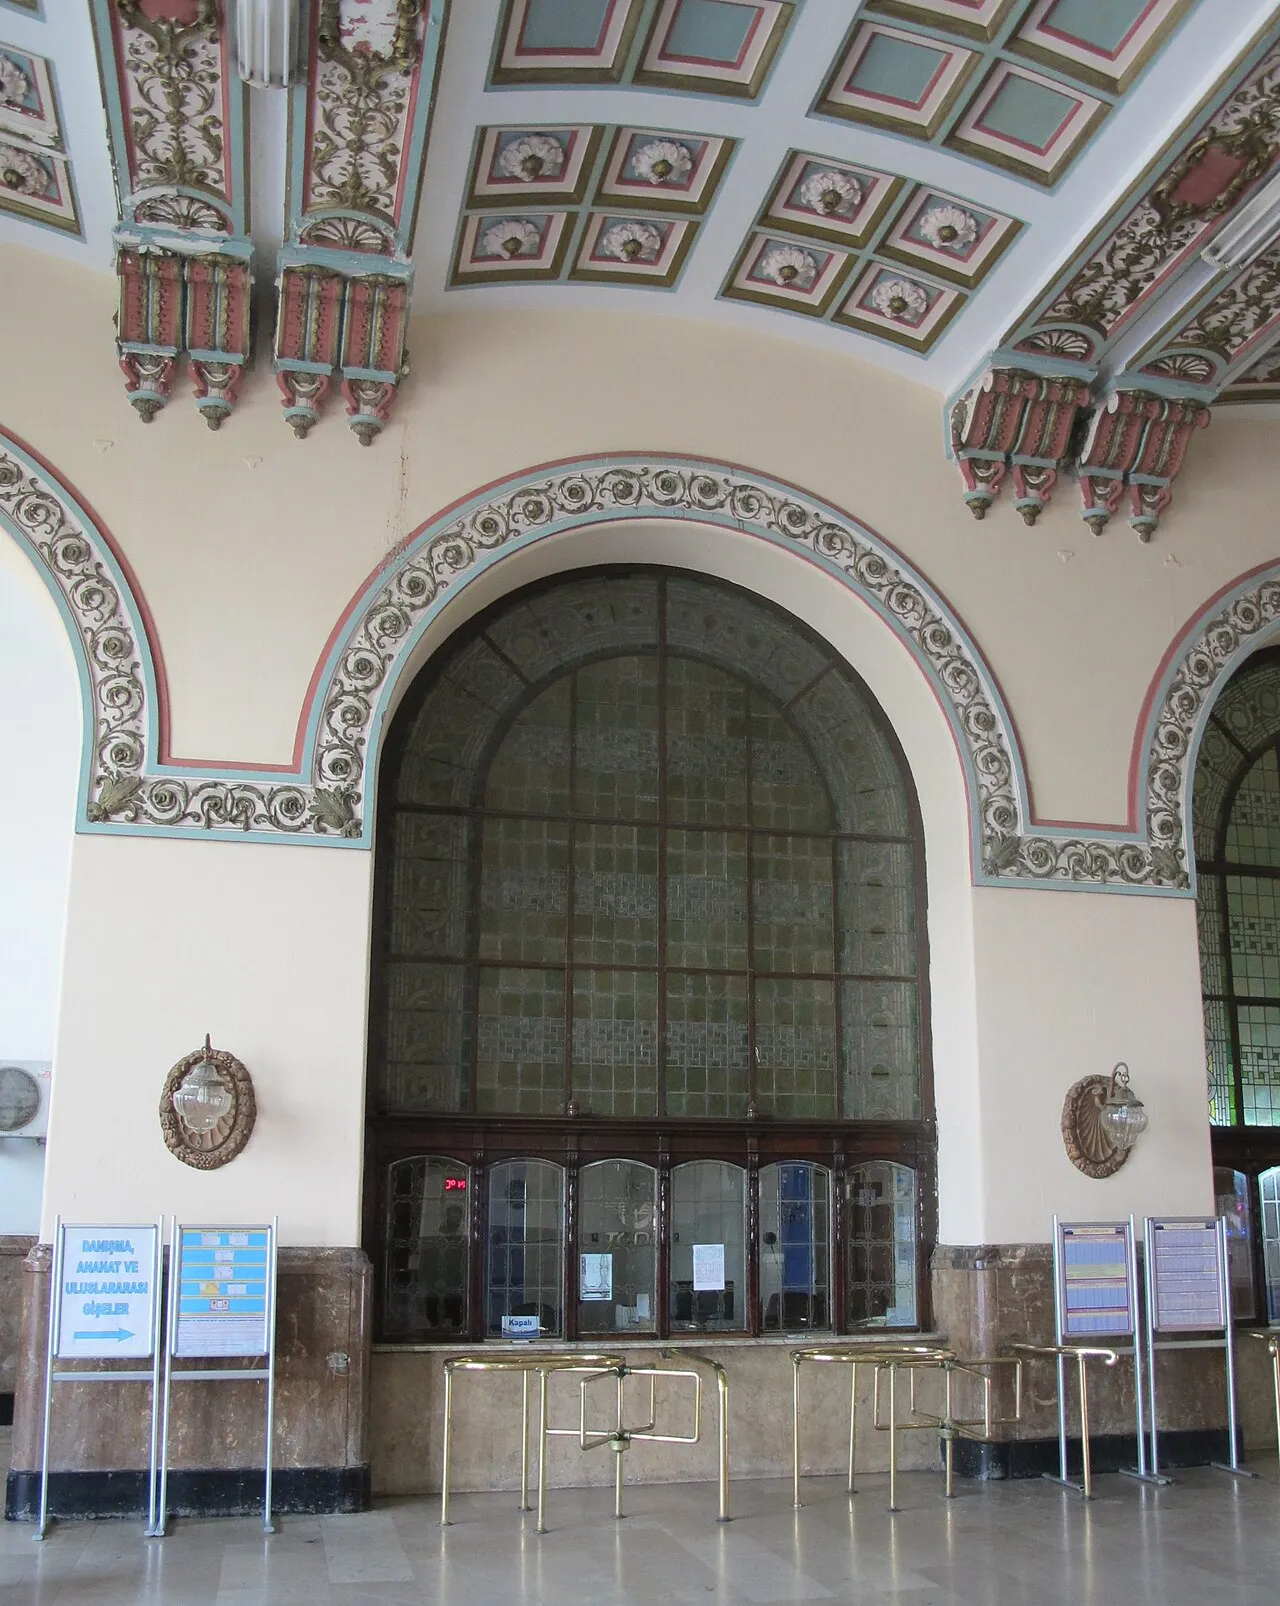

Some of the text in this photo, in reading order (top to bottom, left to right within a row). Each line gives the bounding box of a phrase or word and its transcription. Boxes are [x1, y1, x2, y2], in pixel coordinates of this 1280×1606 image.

[82, 1240, 135, 1255] DANIŞMA,
[124, 1260, 139, 1274] VE
[65, 1281, 148, 1295] ULUSLARARASI
[83, 1300, 129, 1318] GİŞELER
[509, 1318, 532, 1327] Kapalı
